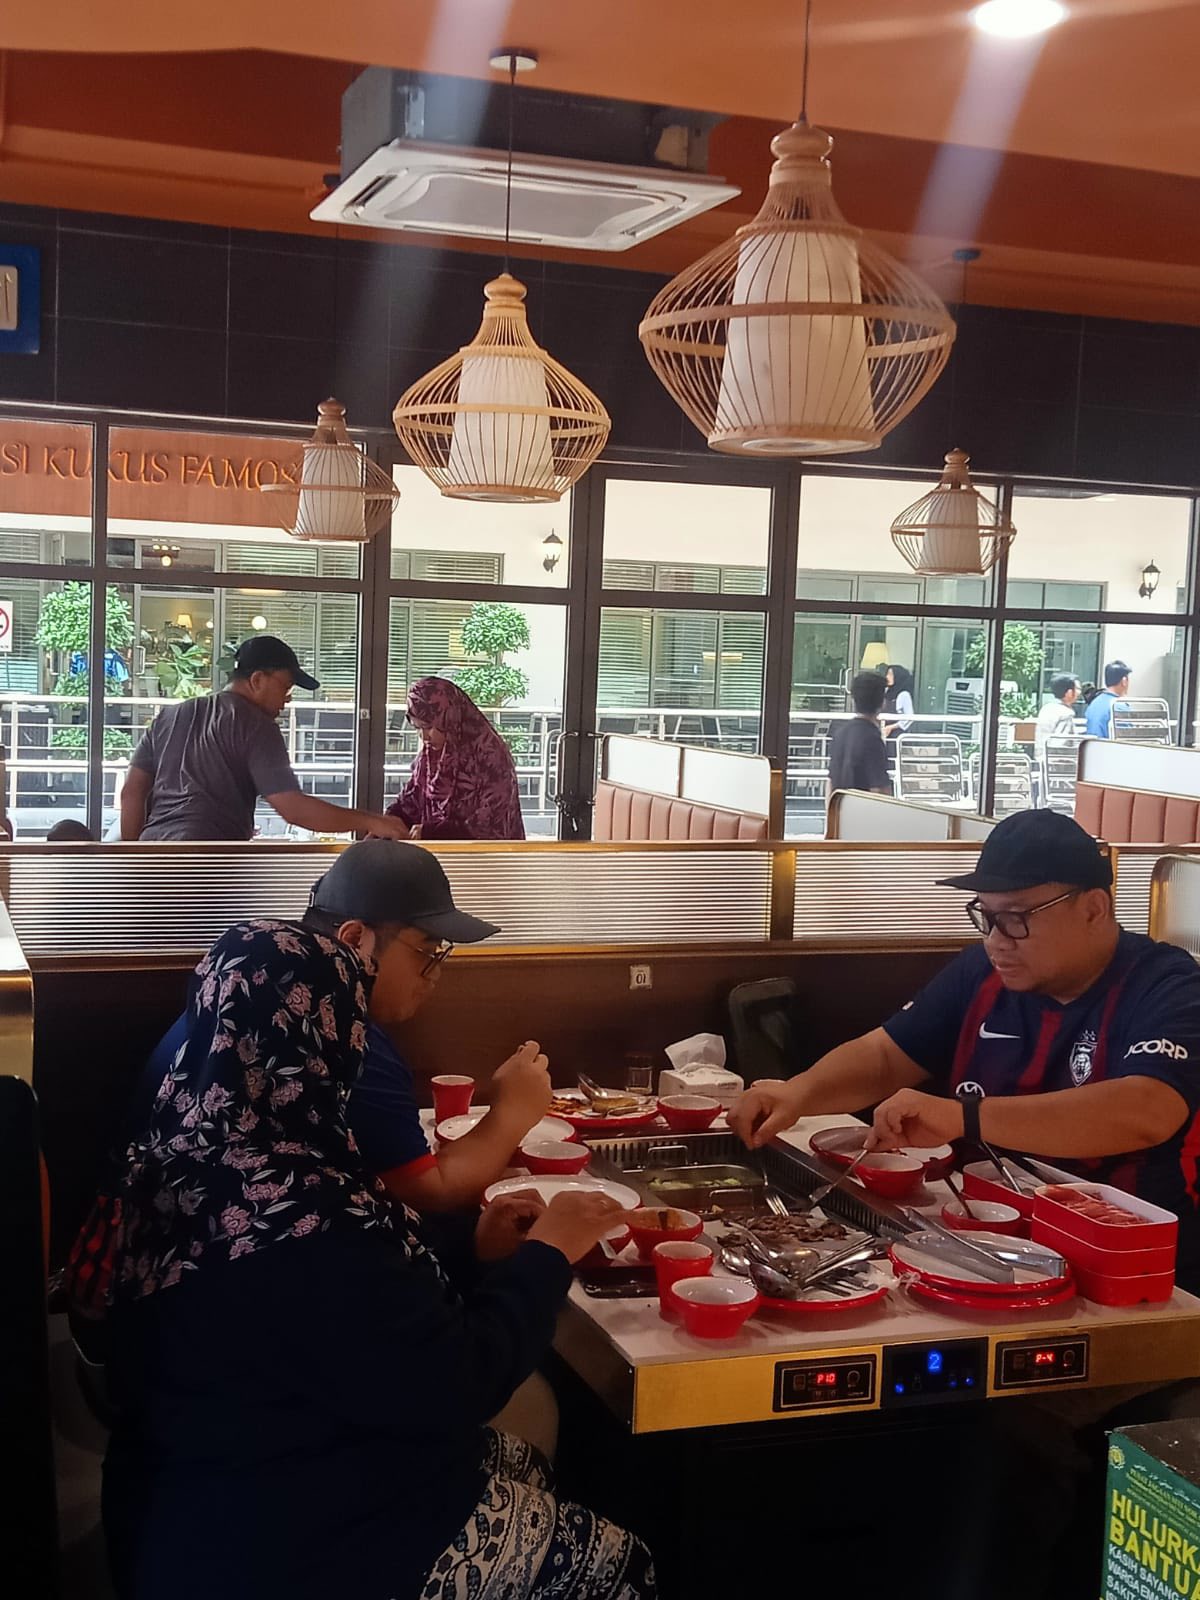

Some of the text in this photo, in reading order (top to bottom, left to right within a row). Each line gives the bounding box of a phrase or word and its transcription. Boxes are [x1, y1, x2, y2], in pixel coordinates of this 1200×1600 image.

[928, 1353, 941, 1371] 2
[1112, 1489, 1200, 1576] HULURK
[1108, 1543, 1138, 1574] KASIH
[1107, 1558, 1140, 1593] WARGA
